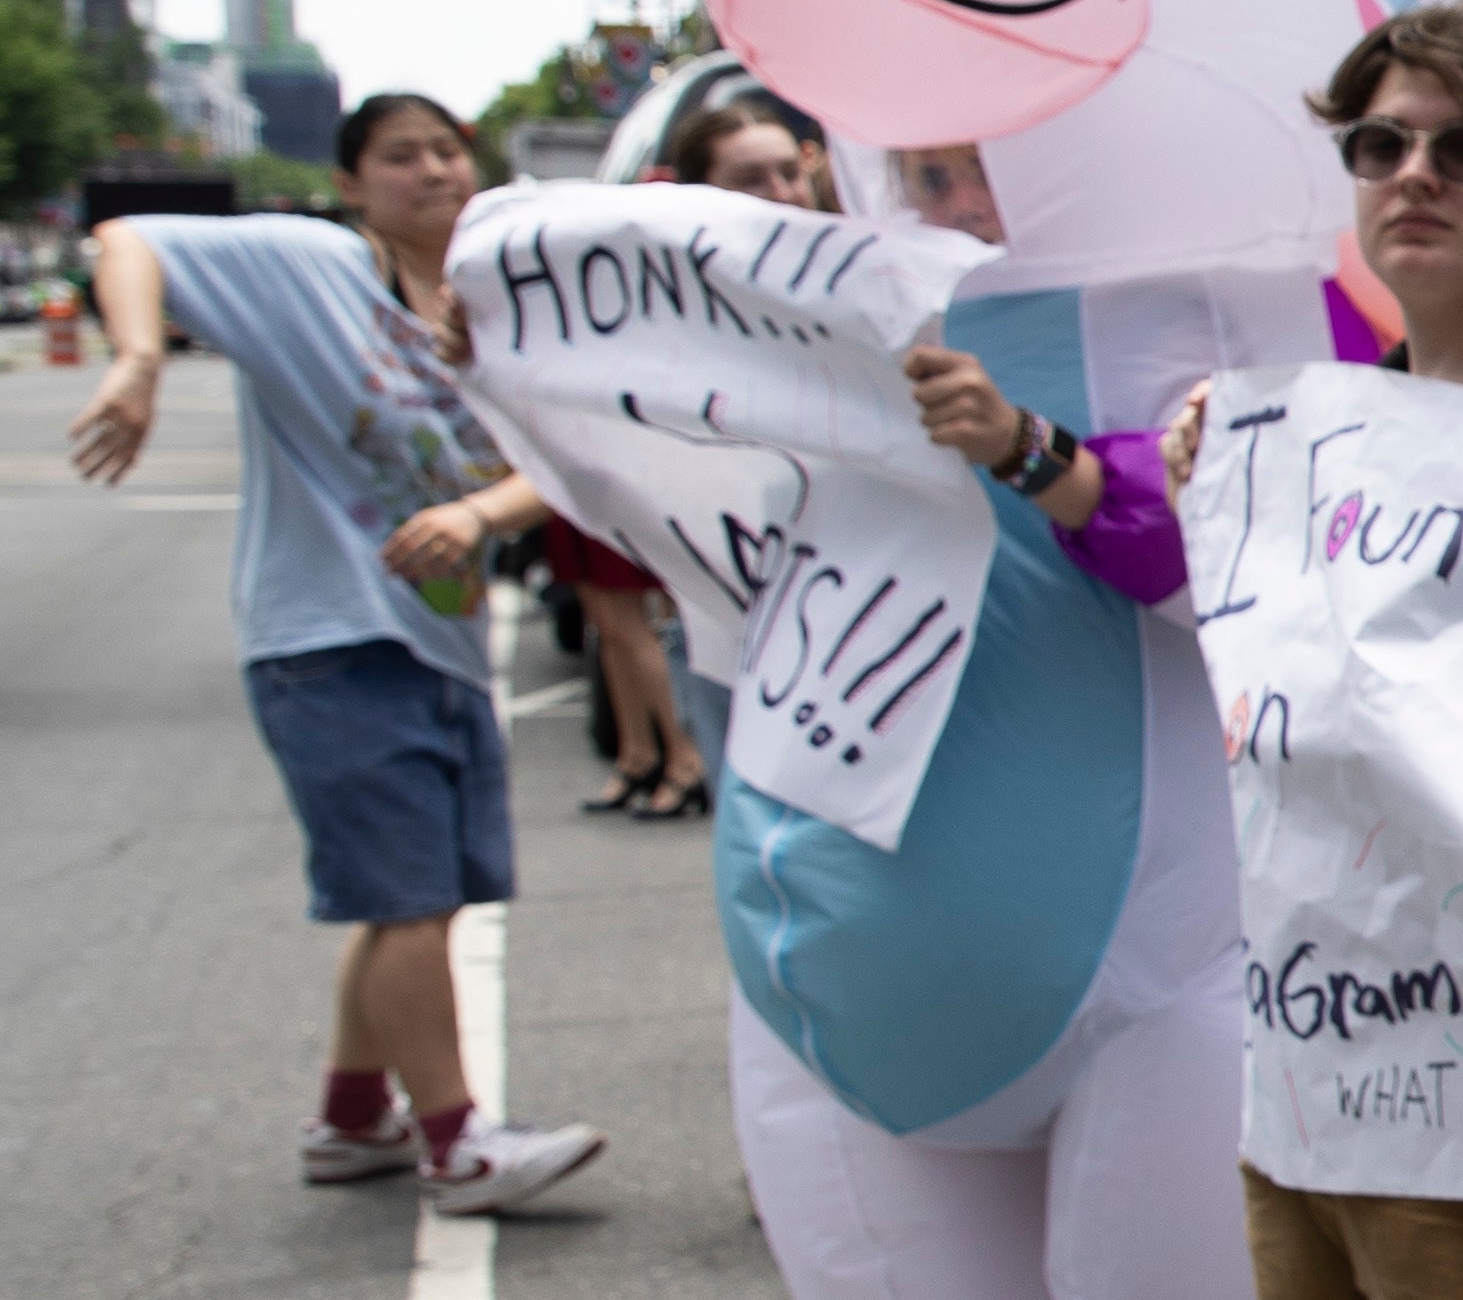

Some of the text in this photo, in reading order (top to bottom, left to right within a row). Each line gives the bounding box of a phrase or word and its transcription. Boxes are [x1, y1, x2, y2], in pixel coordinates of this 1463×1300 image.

[499, 221, 878, 353] HONK!!!
[1198, 407, 1287, 625] I
[1335, 1061, 1458, 1130] WHAT
